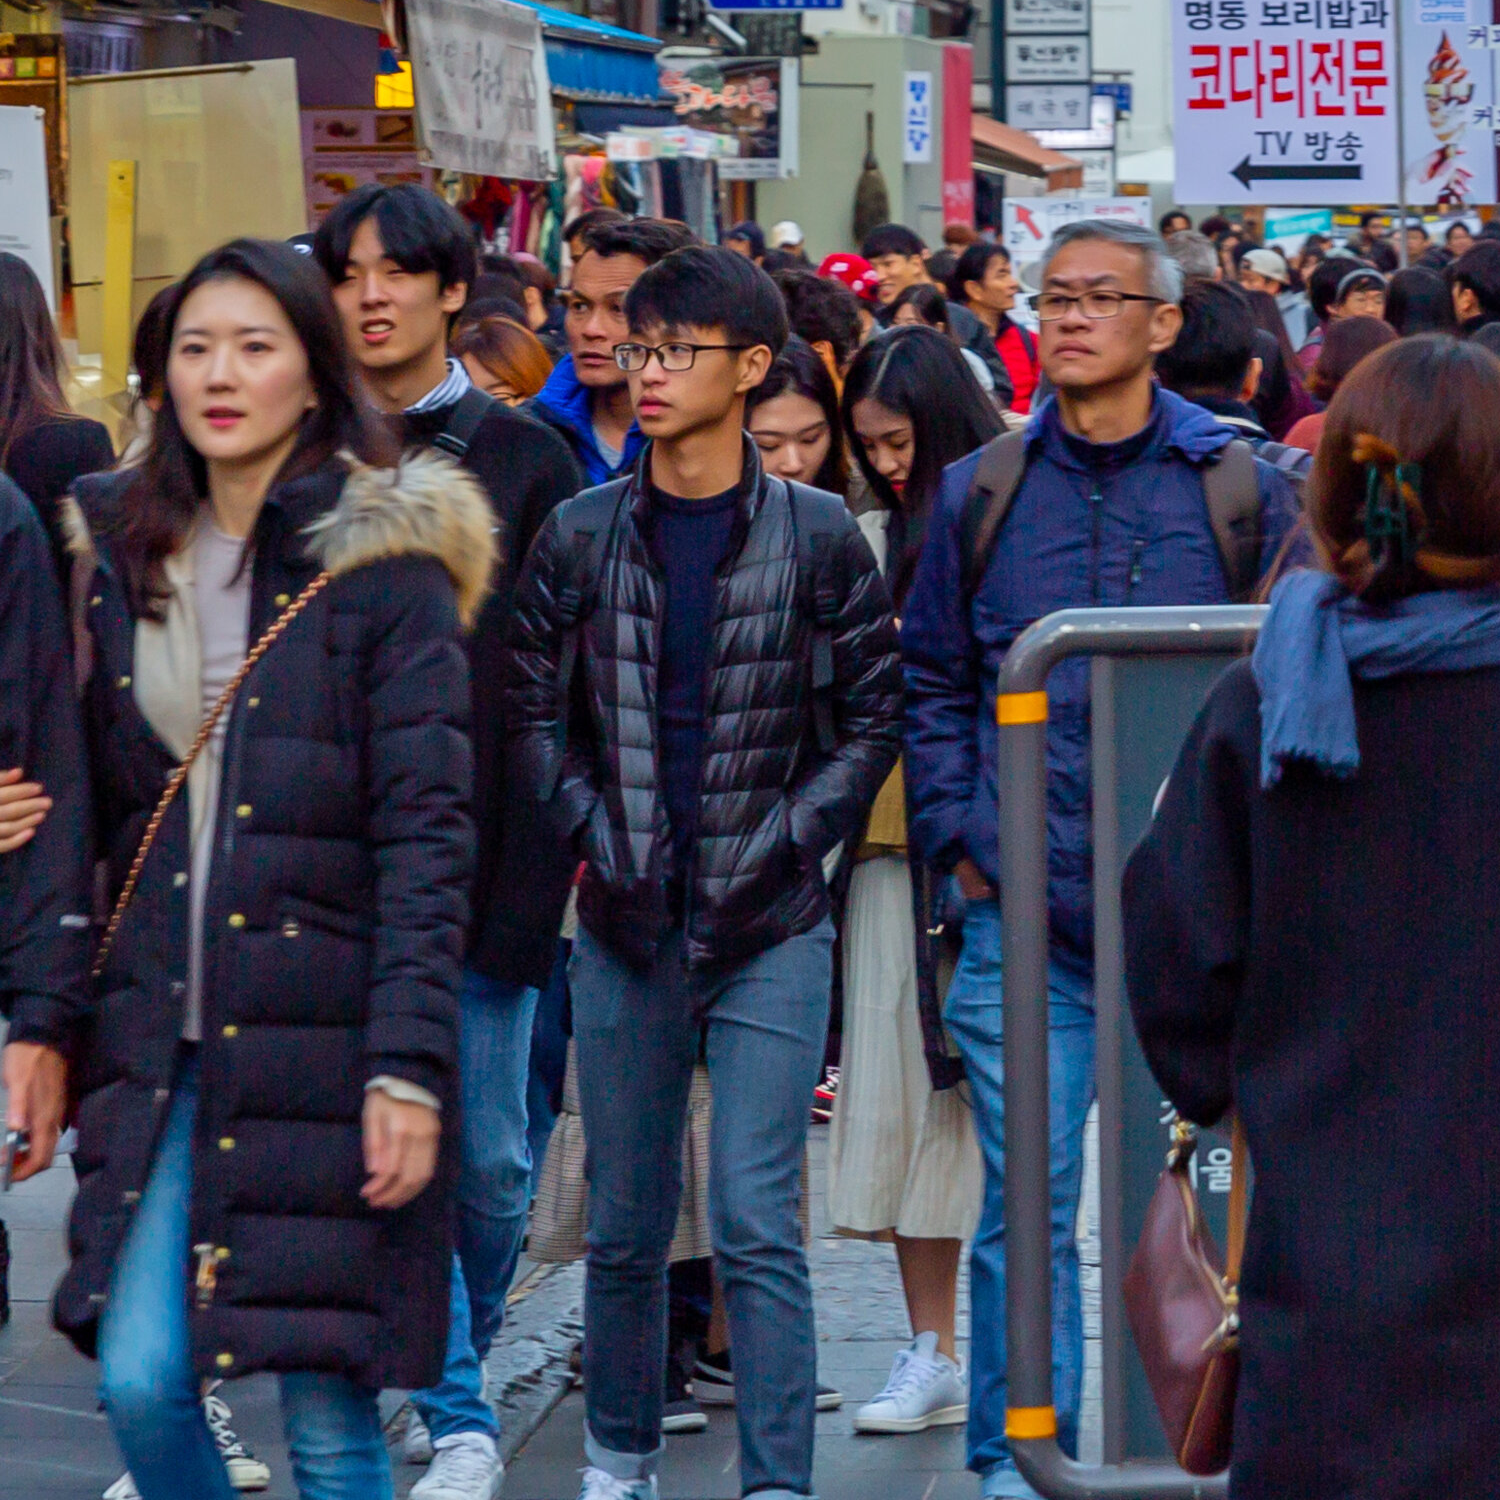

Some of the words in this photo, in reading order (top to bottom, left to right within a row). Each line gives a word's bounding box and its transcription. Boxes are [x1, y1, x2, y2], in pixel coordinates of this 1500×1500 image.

[1184, 0, 1247, 30] 명동
[1187, 38, 1389, 119] 코다리전문
[1254, 130, 1293, 156] TV
[1304, 130, 1364, 162] 방송
